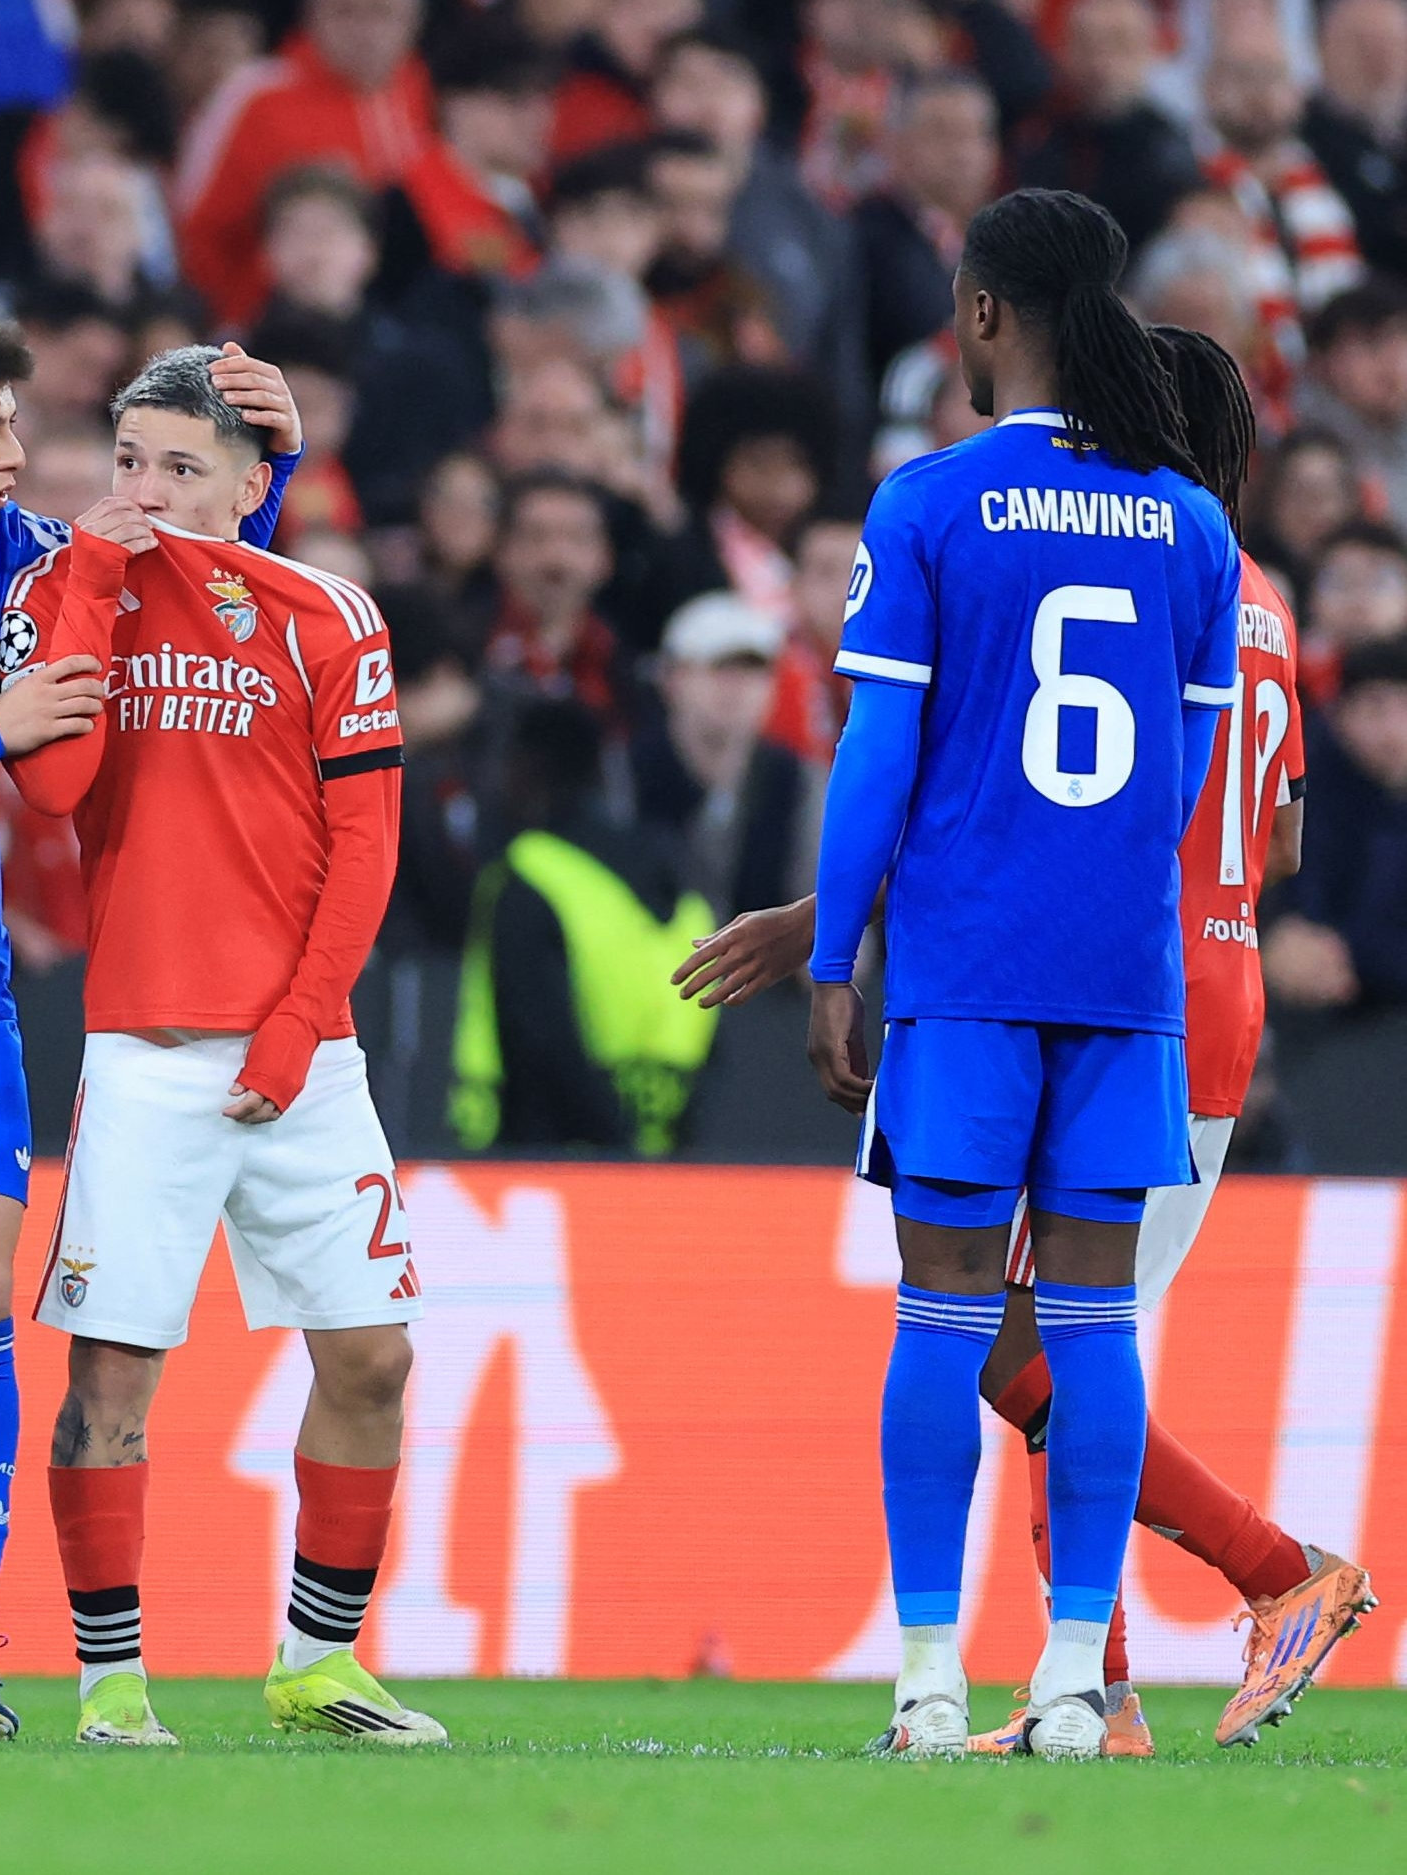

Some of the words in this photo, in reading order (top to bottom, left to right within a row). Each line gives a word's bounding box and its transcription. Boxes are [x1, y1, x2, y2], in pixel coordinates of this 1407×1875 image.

[979, 487, 1176, 546] CAMAVINGA
[119, 694, 154, 732] FLY
[159, 694, 255, 737] BETTER
[1021, 583, 1138, 808] 6
